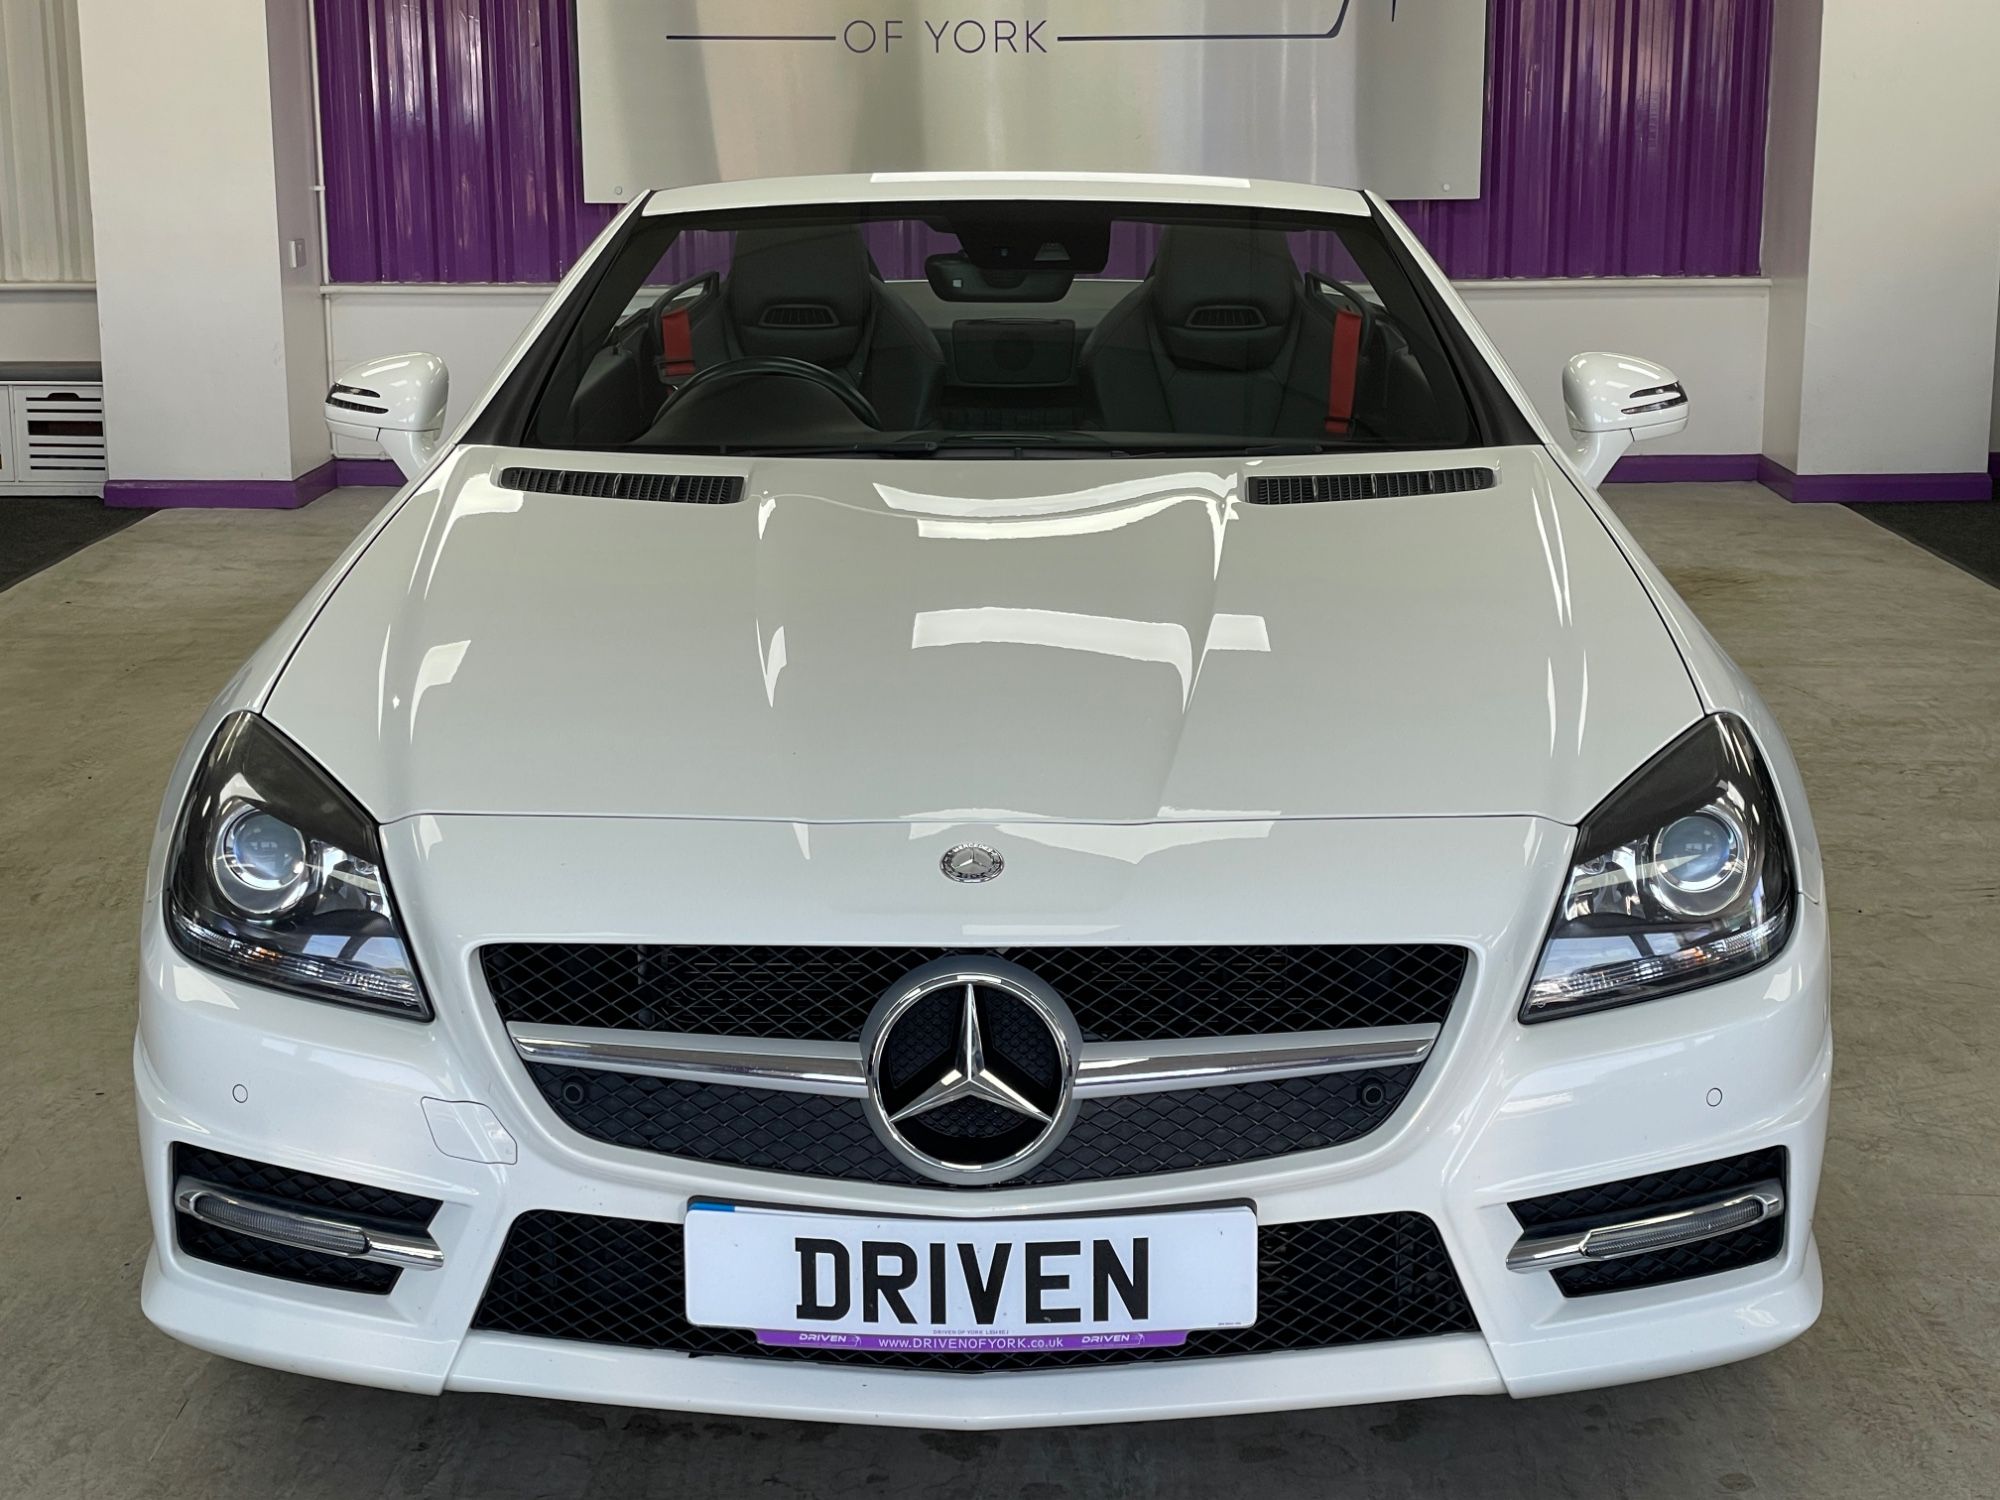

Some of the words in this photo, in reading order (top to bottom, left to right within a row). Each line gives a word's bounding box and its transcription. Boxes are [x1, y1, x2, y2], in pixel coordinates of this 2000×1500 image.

[844, 20, 903, 53] OF
[925, 20, 1047, 53] YORK
[794, 1237, 1149, 1325] DRIVEN
[799, 1333, 847, 1343] DRIVEN
[878, 1337, 1064, 1350] www.DRIVENOFYORK.co.uk
[1081, 1334, 1130, 1344] DRIVEN
